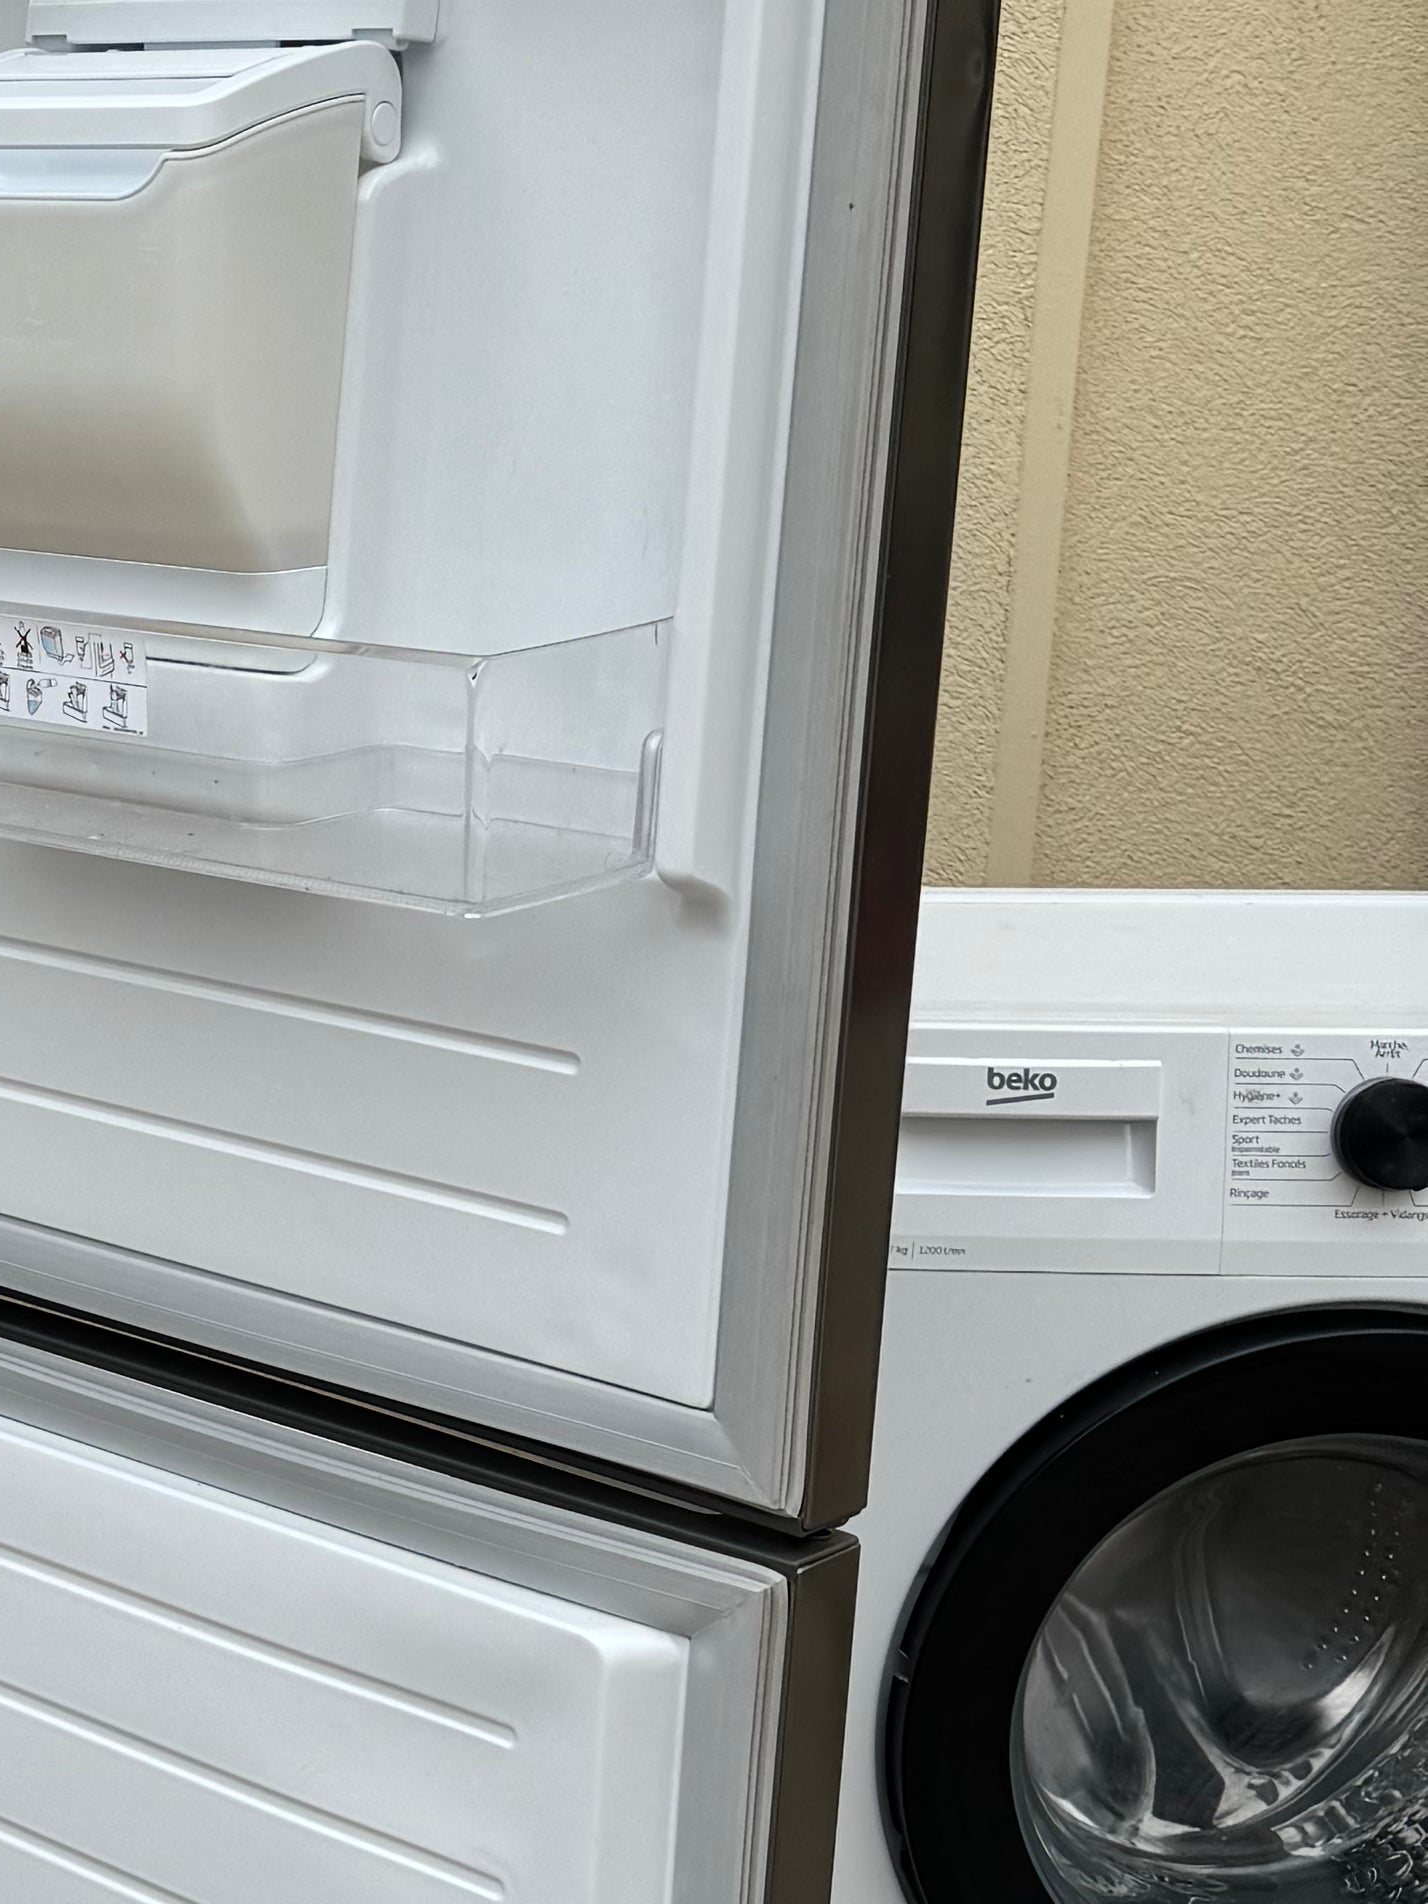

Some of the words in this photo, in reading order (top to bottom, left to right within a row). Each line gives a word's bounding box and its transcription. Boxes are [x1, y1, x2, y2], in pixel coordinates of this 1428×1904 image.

[1236, 1045, 1283, 1054] Chemises
[1235, 1069, 1285, 1078] Doudoune
[987, 1068, 1057, 1092] beko
[1233, 1115, 1265, 1126] Expert
[1269, 1115, 1301, 1124] Taches
[1232, 1135, 1259, 1144] Sport
[1233, 1159, 1269, 1168] Textiles
[1230, 1188, 1269, 1199] Rinçage
